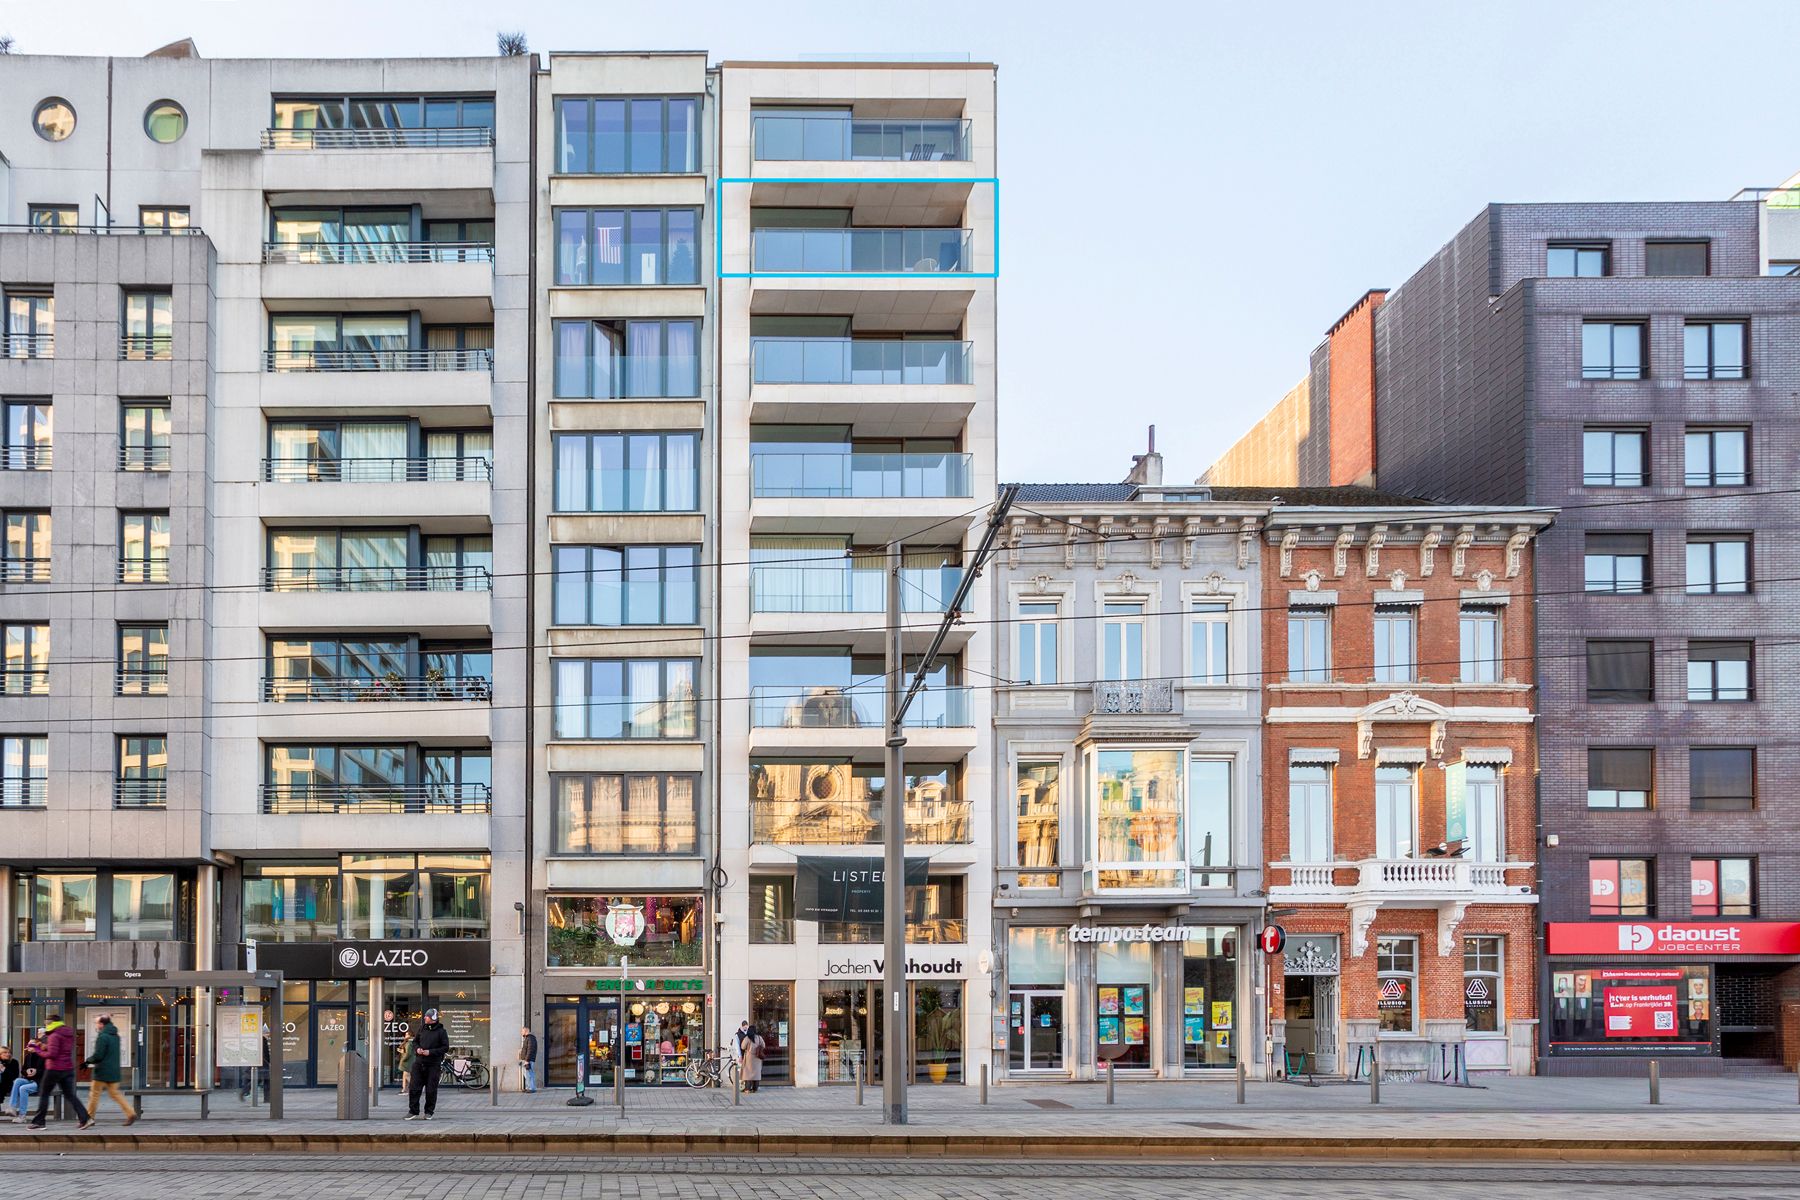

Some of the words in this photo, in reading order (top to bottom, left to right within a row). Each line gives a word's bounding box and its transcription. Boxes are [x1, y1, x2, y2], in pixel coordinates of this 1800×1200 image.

[1658, 925, 1741, 941] daoust
[1658, 943, 1741, 951] JOBCENTER
[363, 949, 428, 966] LAZEO
[825, 958, 872, 976] Jochen
[873, 958, 962, 974] Vhoudt
